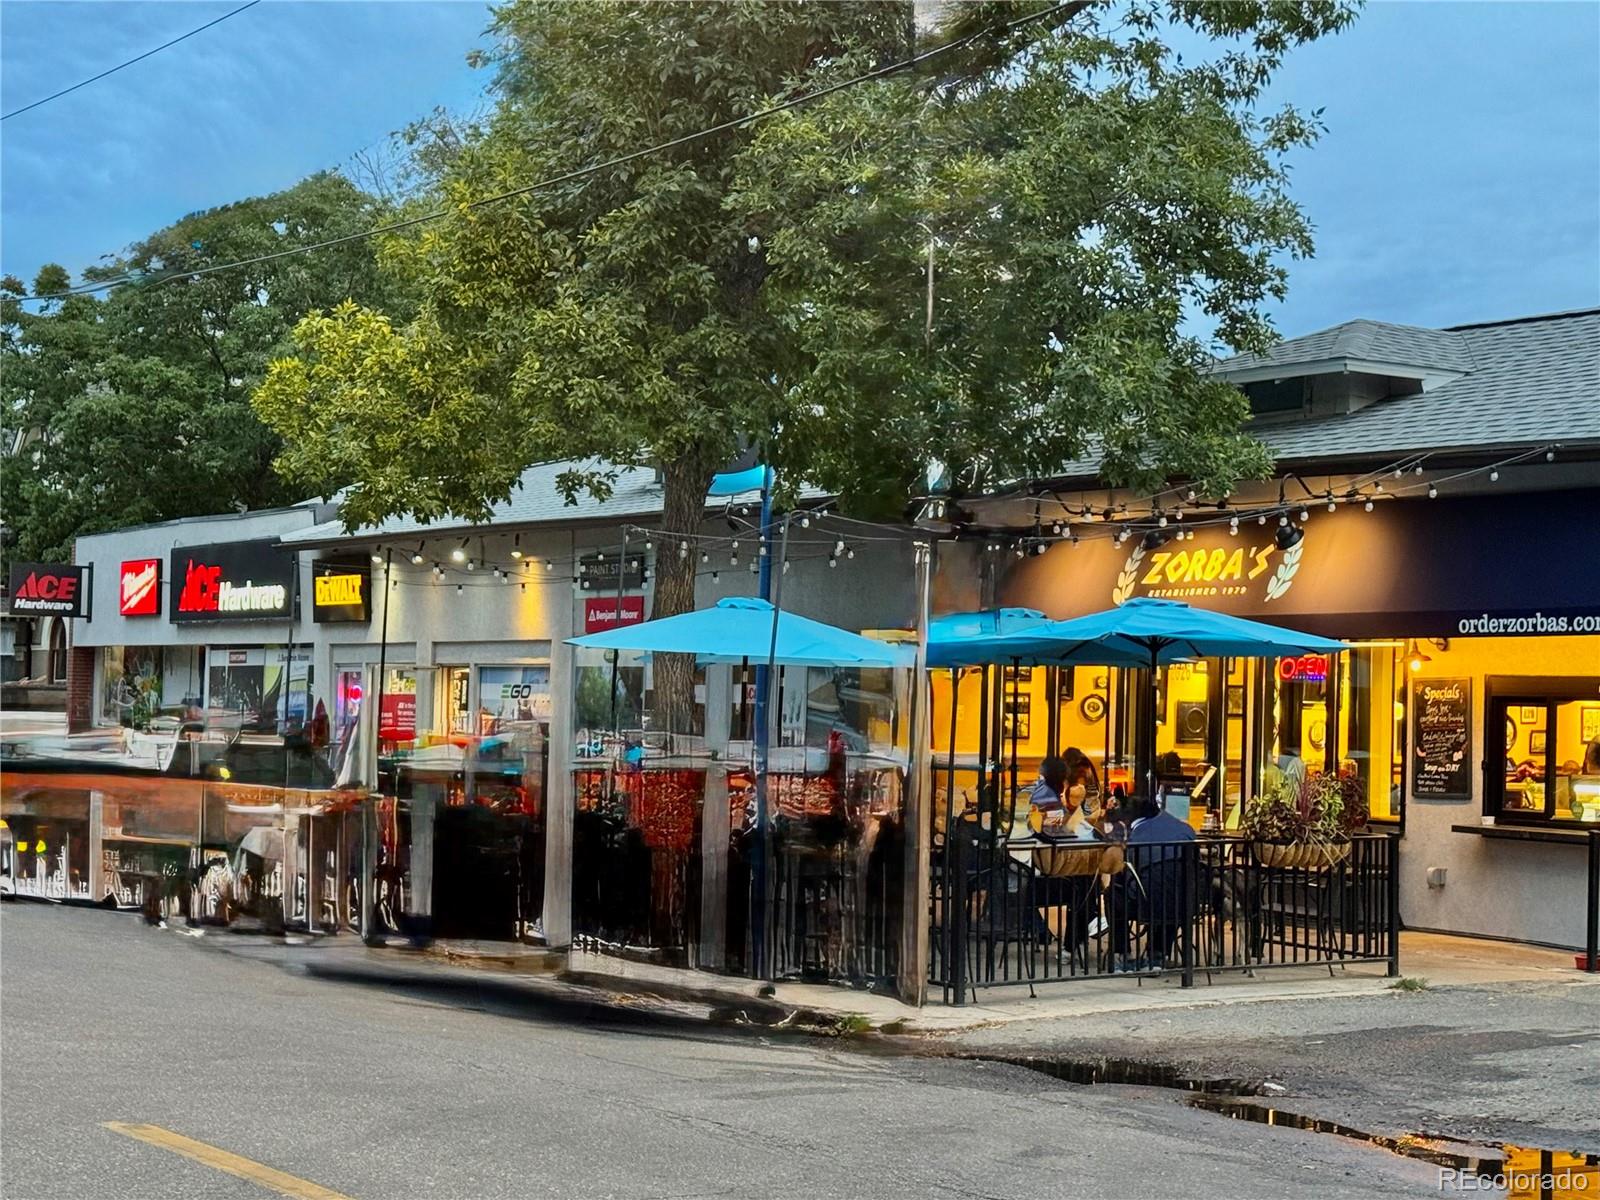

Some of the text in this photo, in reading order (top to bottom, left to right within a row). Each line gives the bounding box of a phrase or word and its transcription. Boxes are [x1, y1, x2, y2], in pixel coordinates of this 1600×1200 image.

[1141, 544, 1275, 584] ZORBA'S
[16, 571, 77, 599] ACE
[179, 559, 222, 612] ACE
[218, 580, 285, 611] Hardware
[1148, 587, 1217, 597] ESTABLISHED
[14, 598, 73, 610] Hardware
[595, 609, 618, 622] Benjami
[1281, 657, 1327, 678] OPEN
[501, 684, 531, 698] EGO
[1424, 683, 1460, 704] Specials
